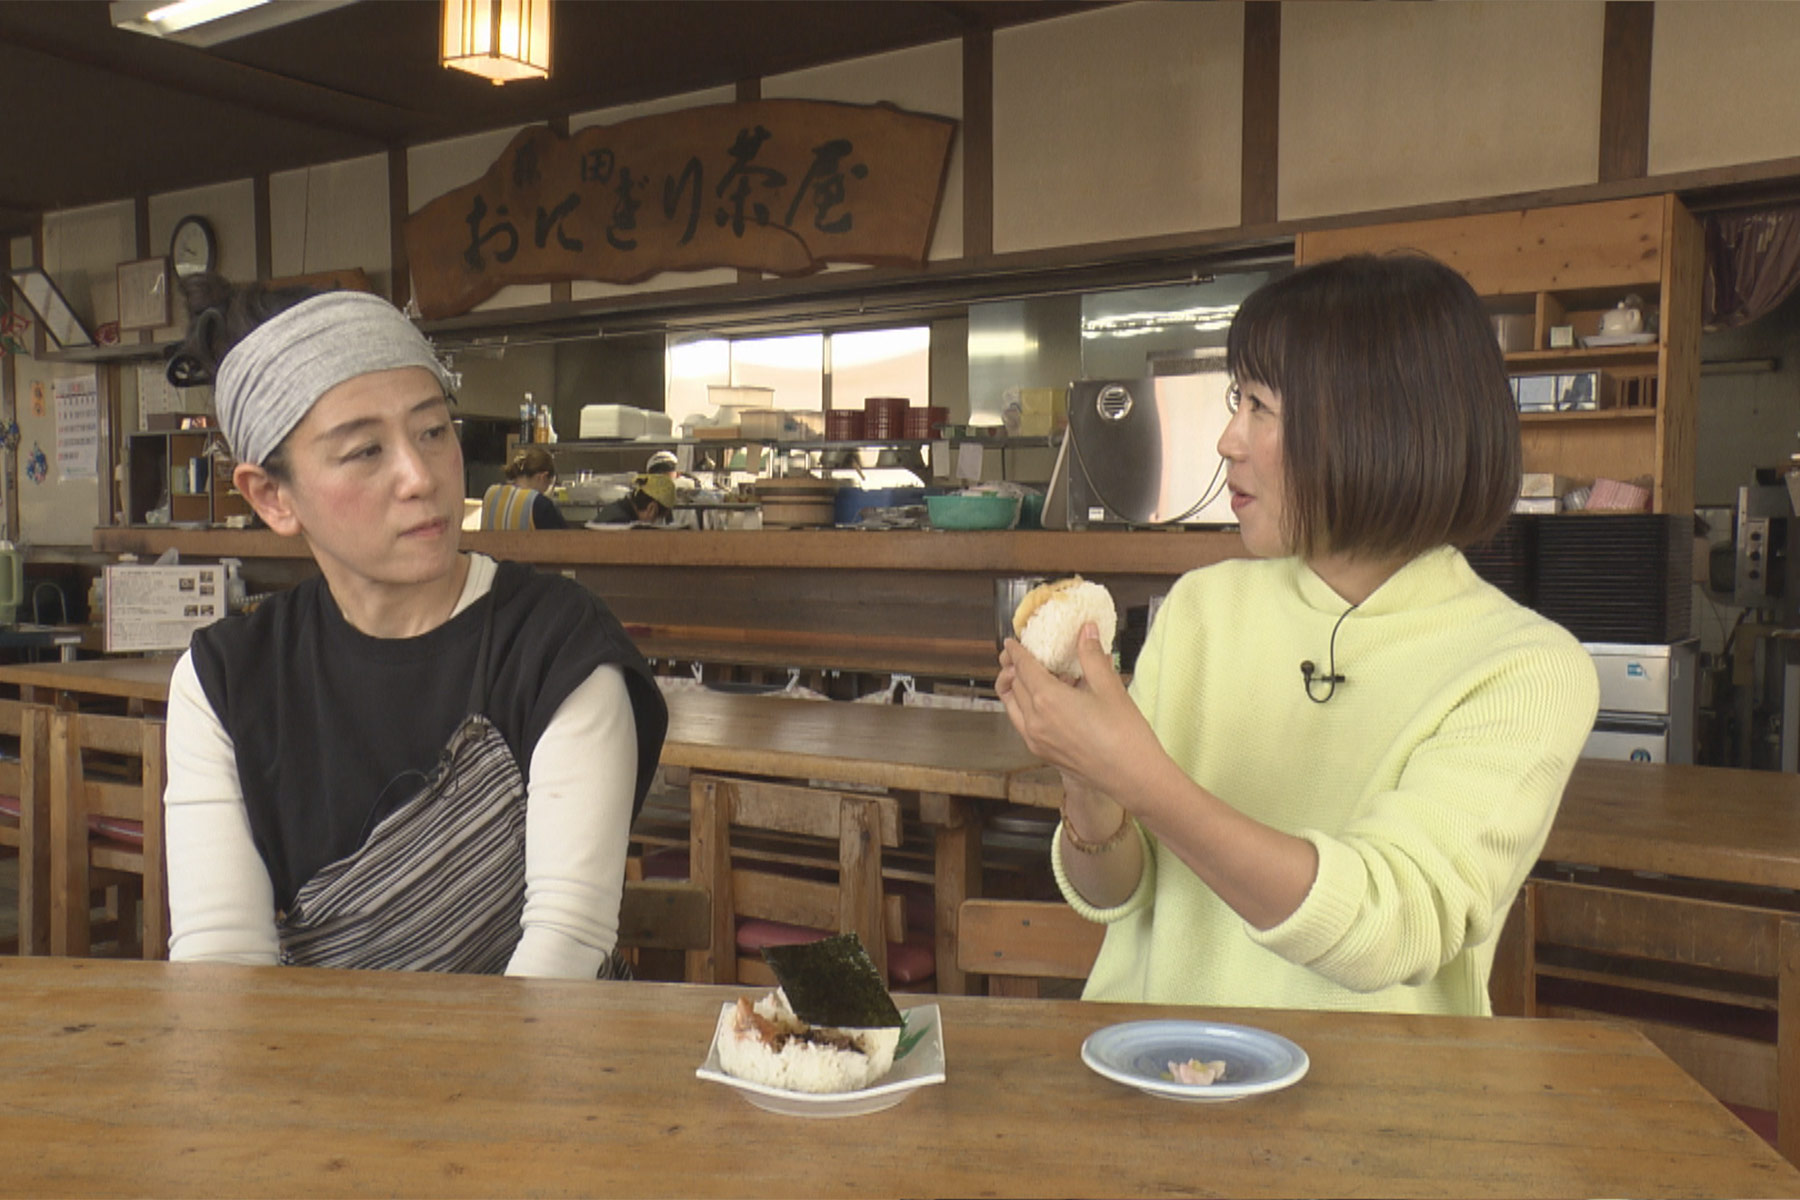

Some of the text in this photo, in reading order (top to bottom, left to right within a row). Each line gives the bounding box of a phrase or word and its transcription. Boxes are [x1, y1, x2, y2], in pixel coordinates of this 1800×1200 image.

[464, 124, 869, 273] おにぎり茶屋
